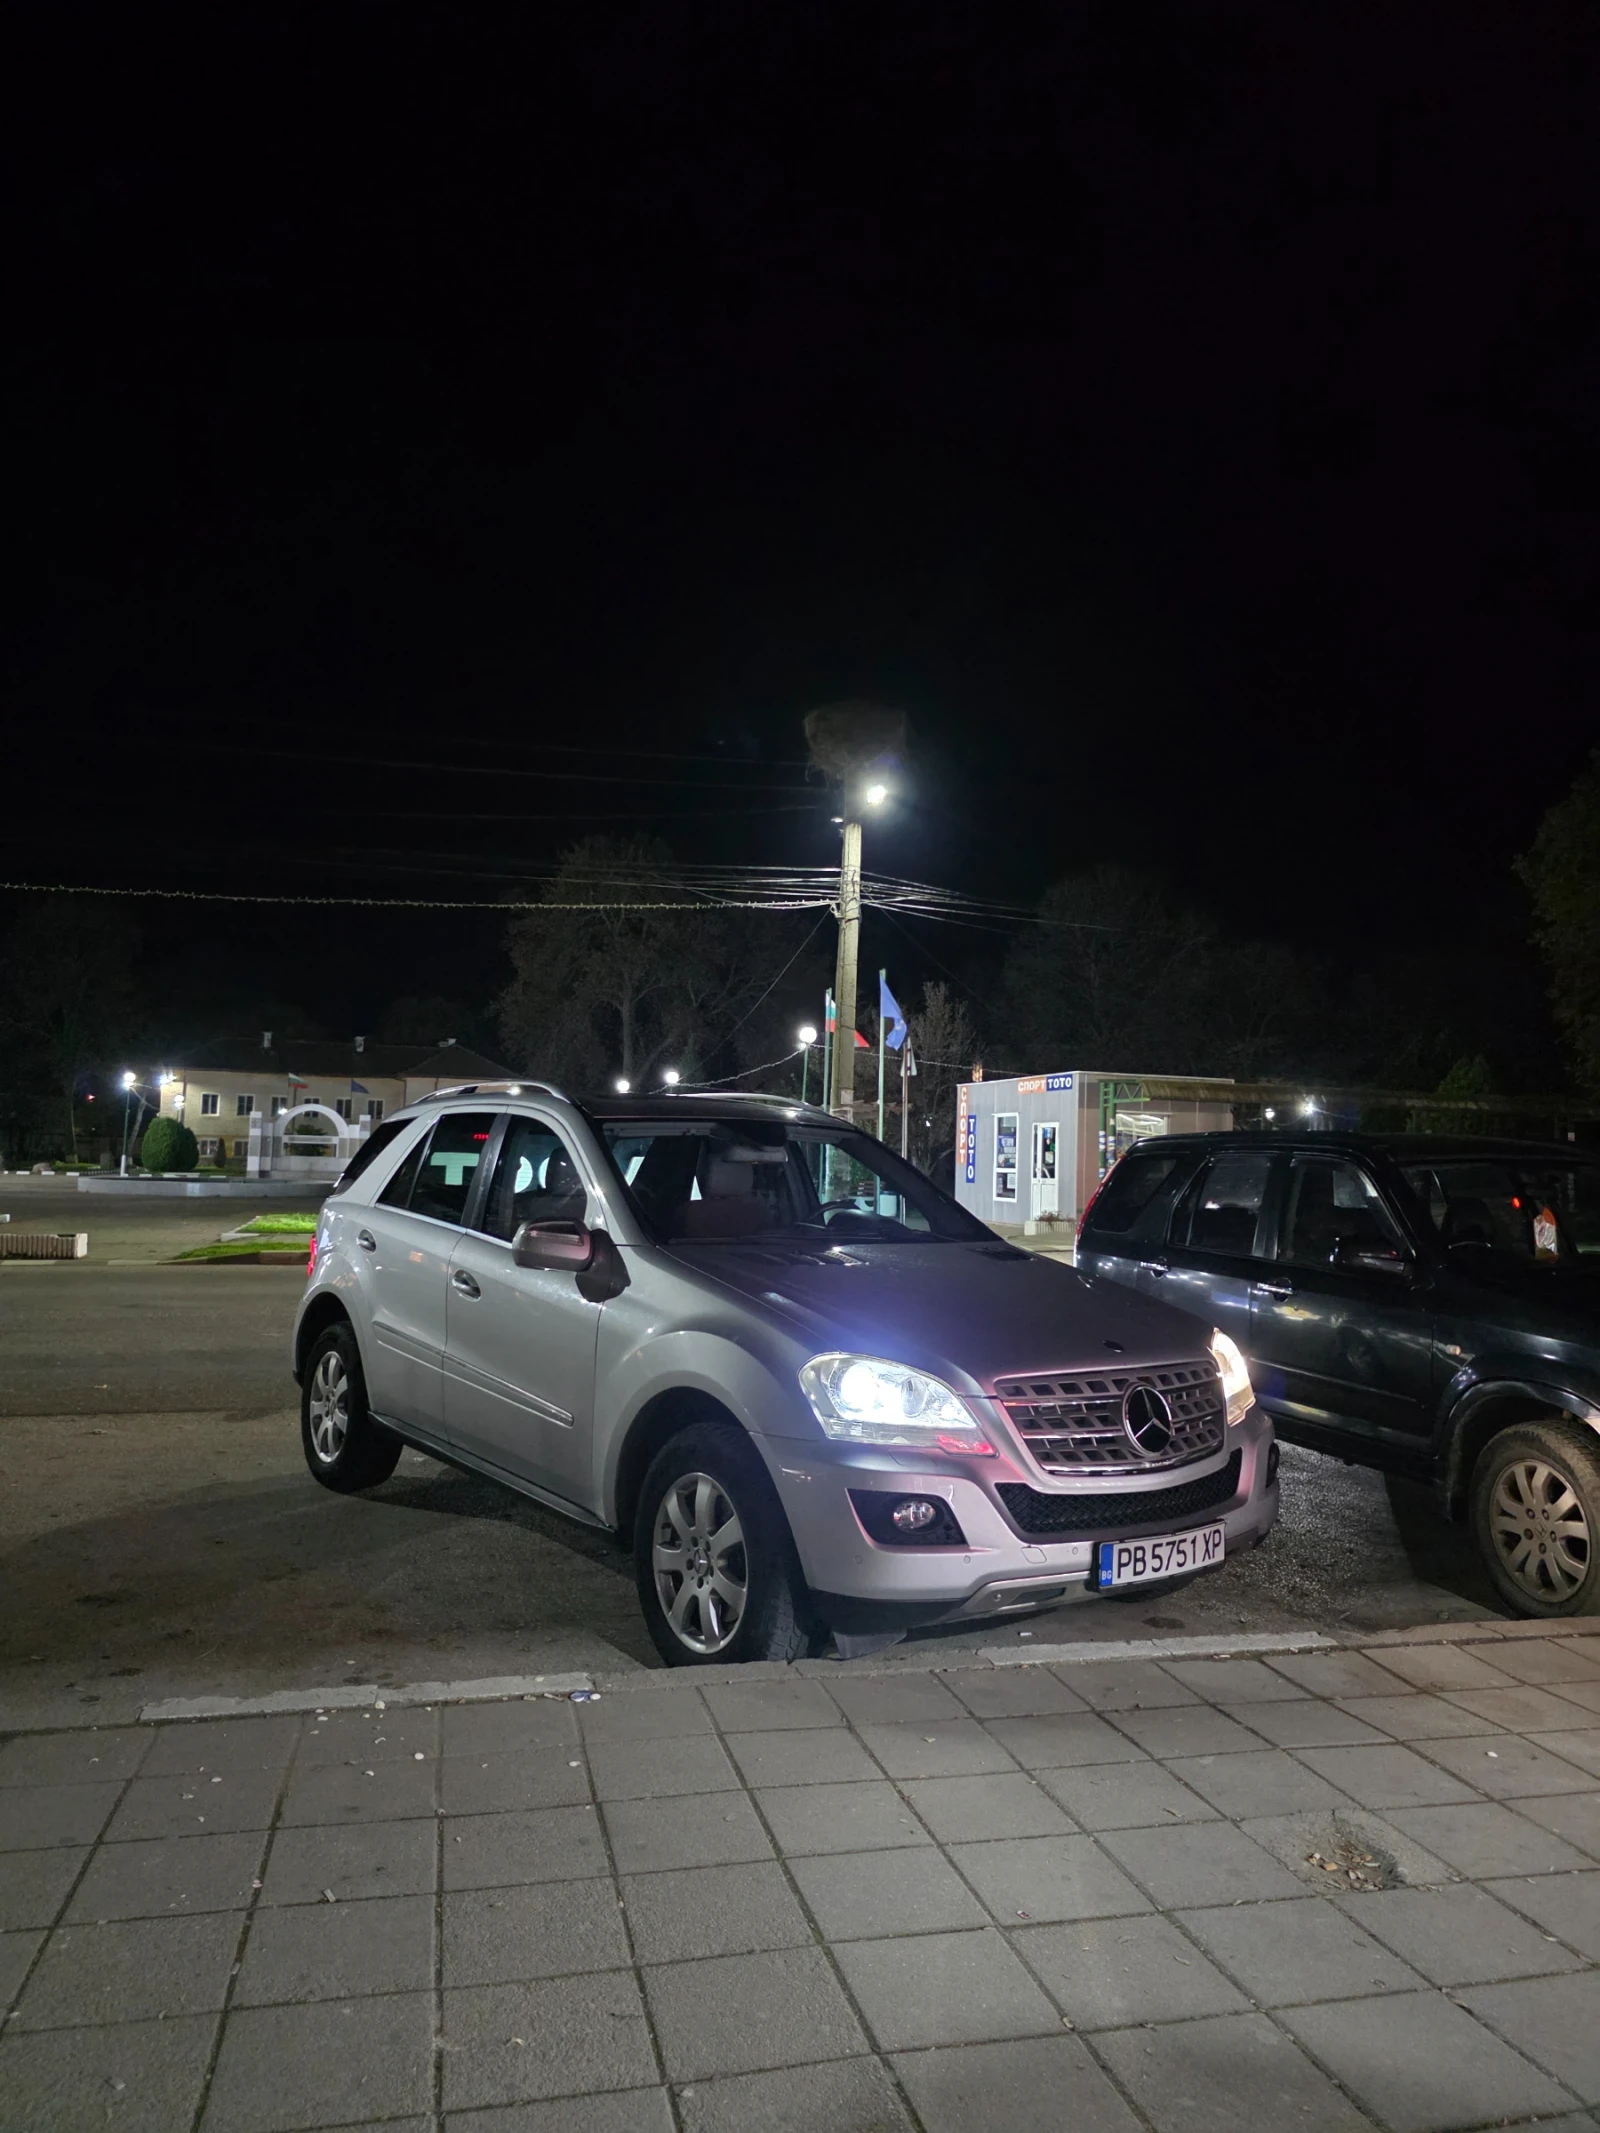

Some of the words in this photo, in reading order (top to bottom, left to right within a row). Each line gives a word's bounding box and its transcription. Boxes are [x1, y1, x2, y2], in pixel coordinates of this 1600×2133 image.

[1018, 1079, 1046, 1092] СПОРТ
[1047, 1077, 1072, 1089] ТОТО
[959, 1087, 967, 1163] СПОРТ
[967, 1119, 975, 1179] ТОТО
[1101, 1570, 1112, 1580] BG
[1117, 1545, 1147, 1579] PB
[1151, 1535, 1197, 1573] 5751
[1202, 1528, 1222, 1562] XP
